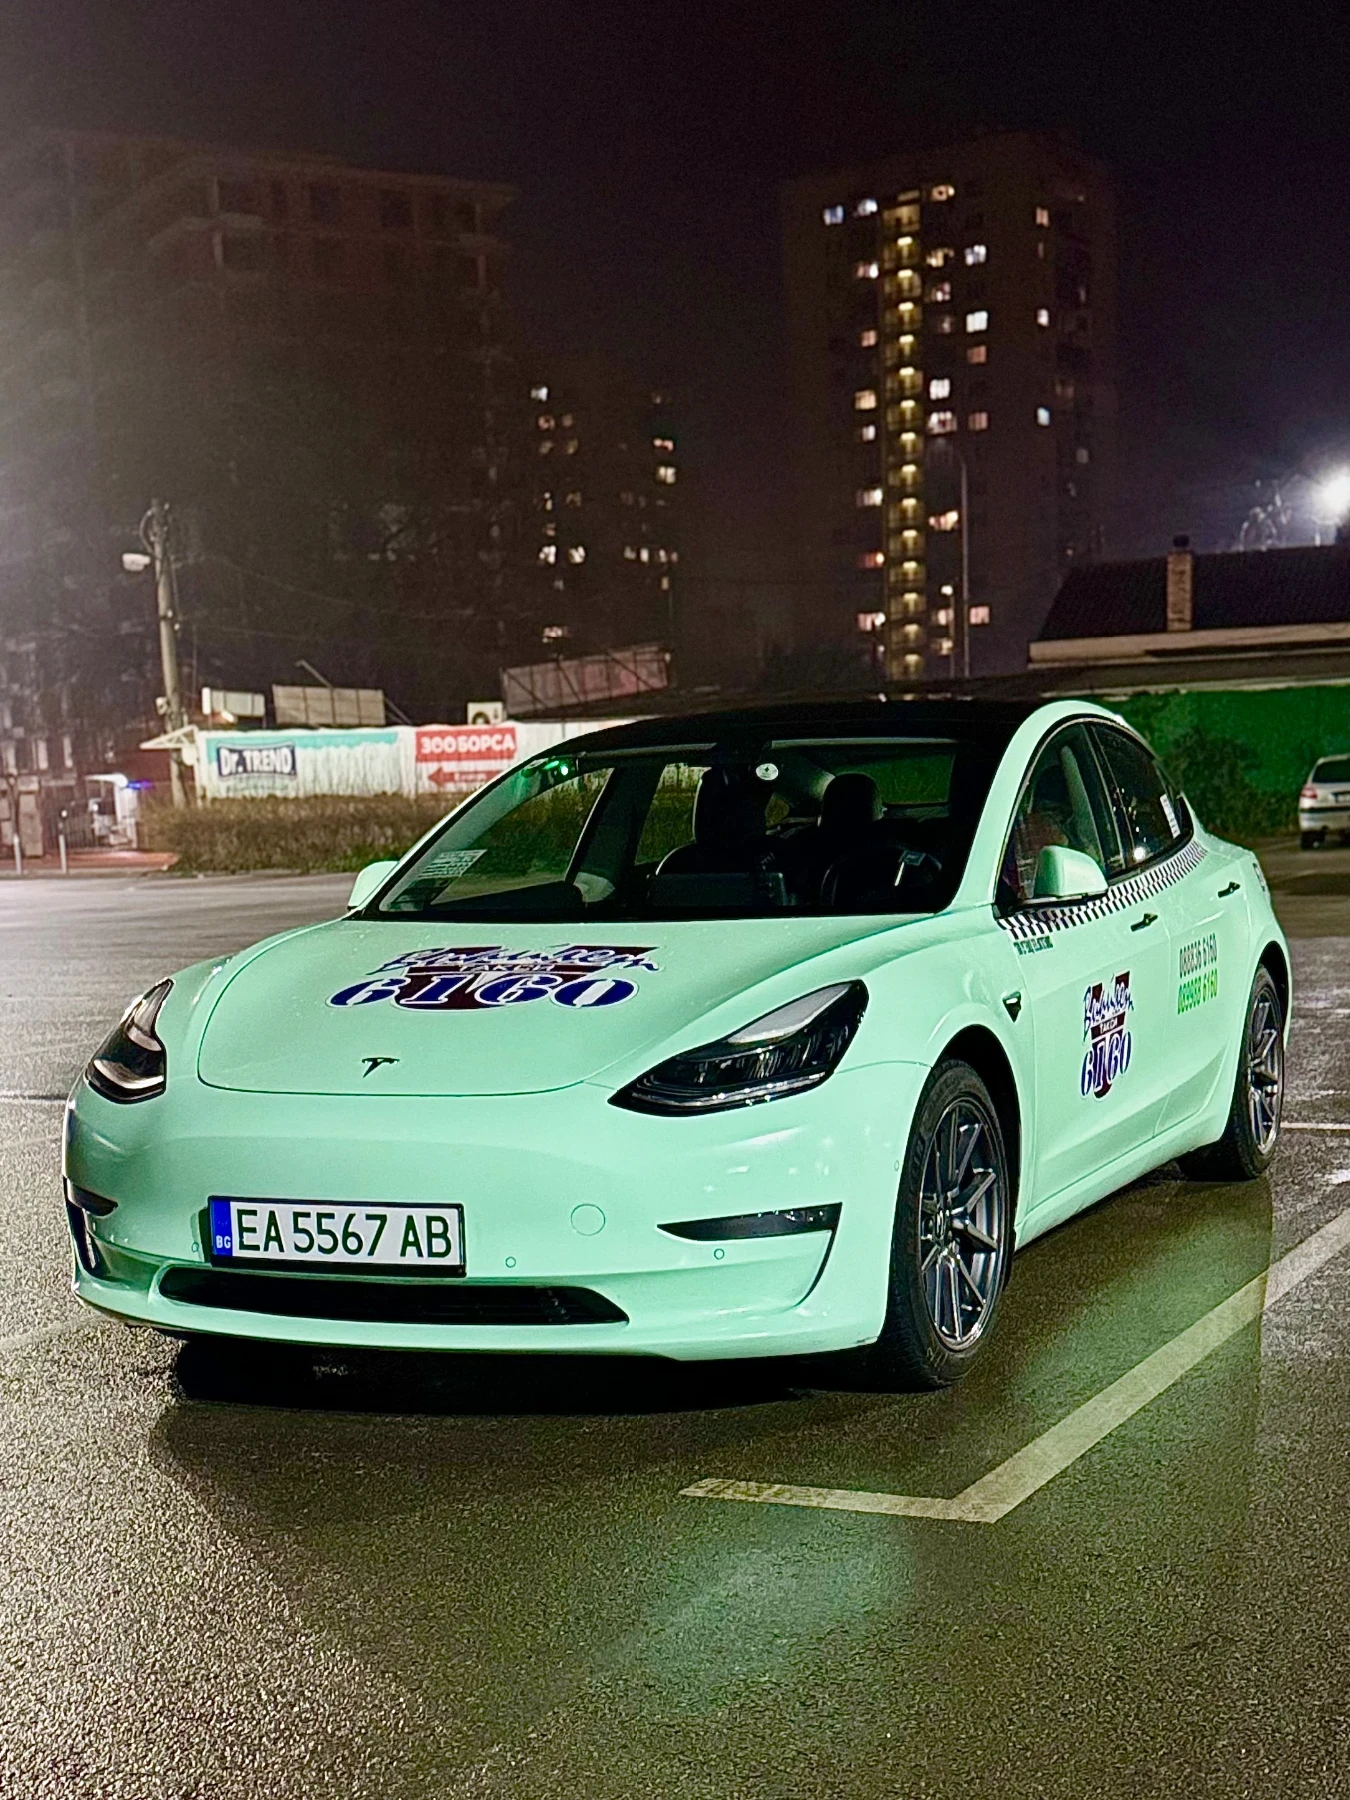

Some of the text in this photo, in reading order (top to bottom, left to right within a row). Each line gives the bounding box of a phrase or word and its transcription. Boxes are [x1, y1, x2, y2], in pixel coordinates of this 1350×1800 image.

[420, 733, 515, 754] ЗООБОРСА
[220, 747, 292, 776] Dr. TREND
[327, 974, 639, 1009] 6160
[1081, 1032, 1132, 1098] 6160
[216, 1235, 231, 1249] BG
[236, 1208, 452, 1259] EA 5567 AB
